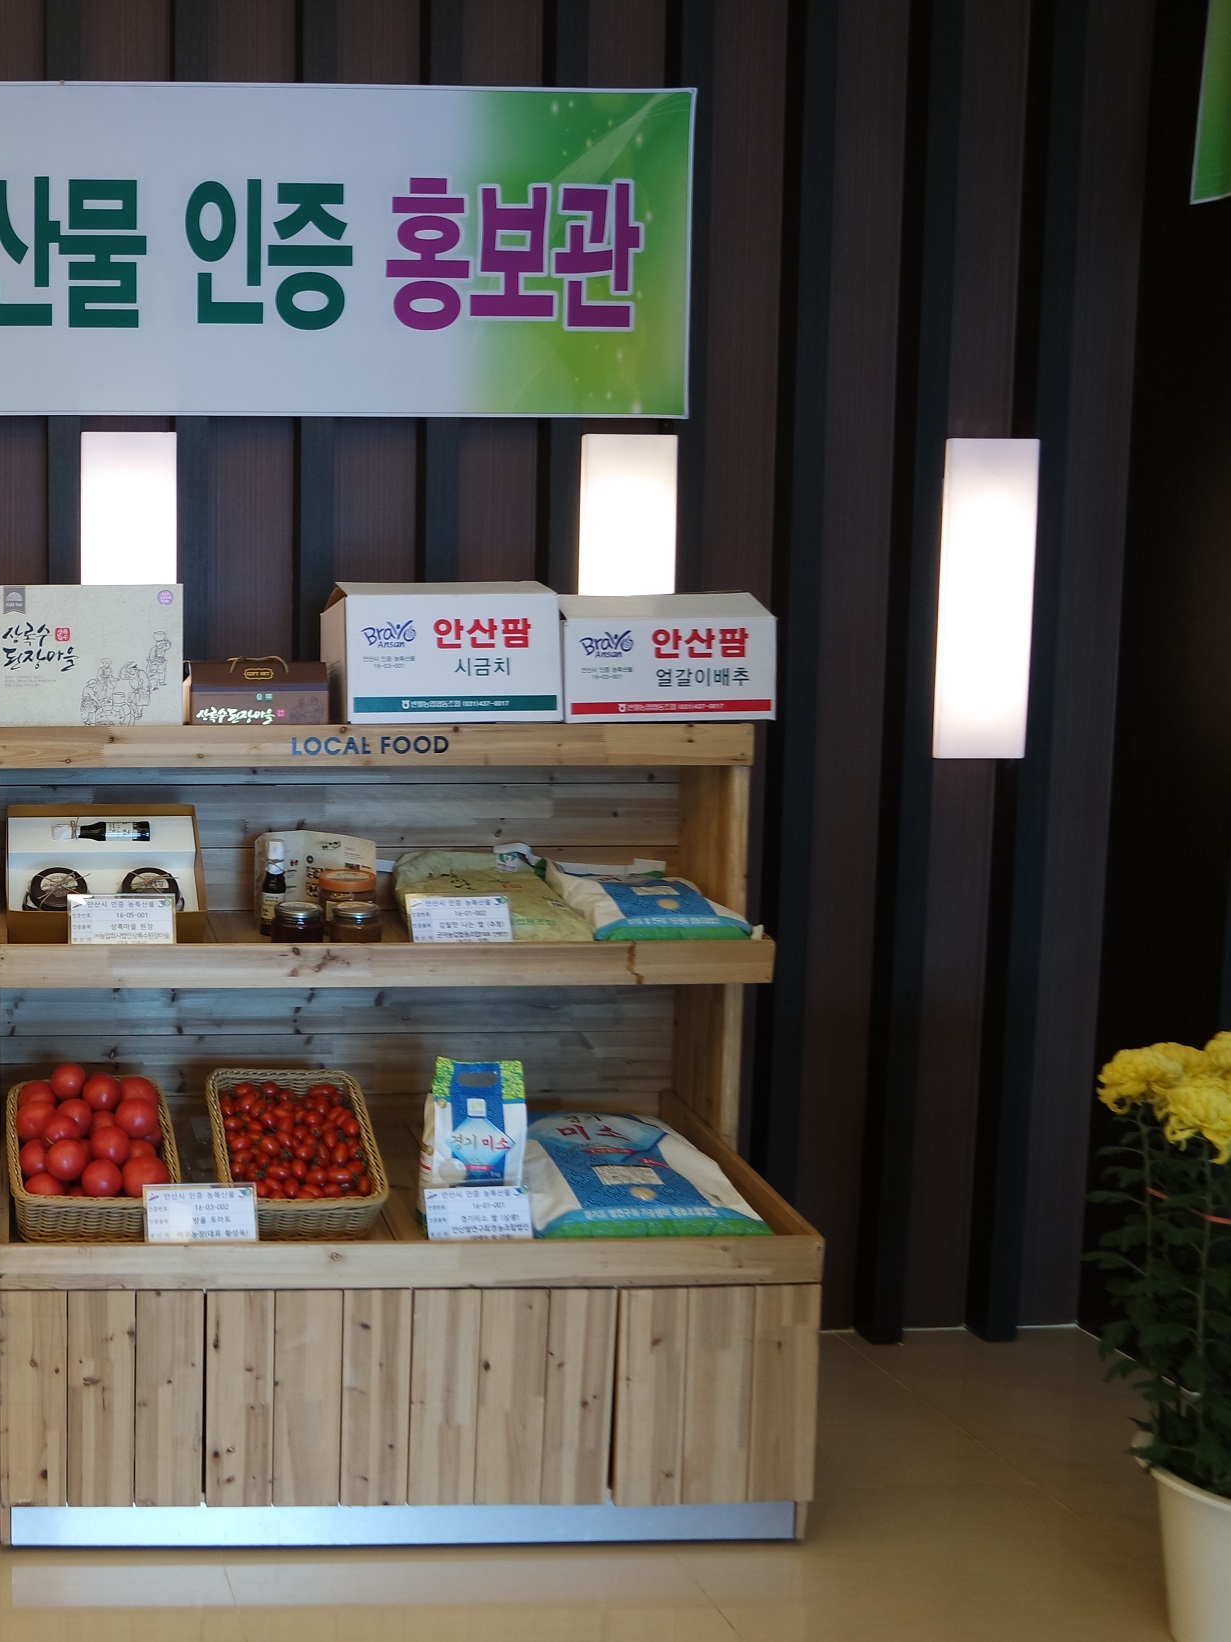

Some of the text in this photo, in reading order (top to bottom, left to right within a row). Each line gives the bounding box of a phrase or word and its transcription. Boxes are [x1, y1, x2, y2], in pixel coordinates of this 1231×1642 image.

[184, 176, 353, 331] 인증
[385, 176, 644, 331] 홍보관
[433, 618, 531, 649] 안산팜
[652, 628, 749, 659] 안산팜
[377, 640, 405, 648] Ansan
[454, 657, 511, 676] 시금치
[656, 667, 750, 688] 얼갈이배추
[291, 735, 449, 755] LOCAL FOOD
[451, 1133, 511, 1152] 경기 미소
[556, 1124, 631, 1142] 미소
